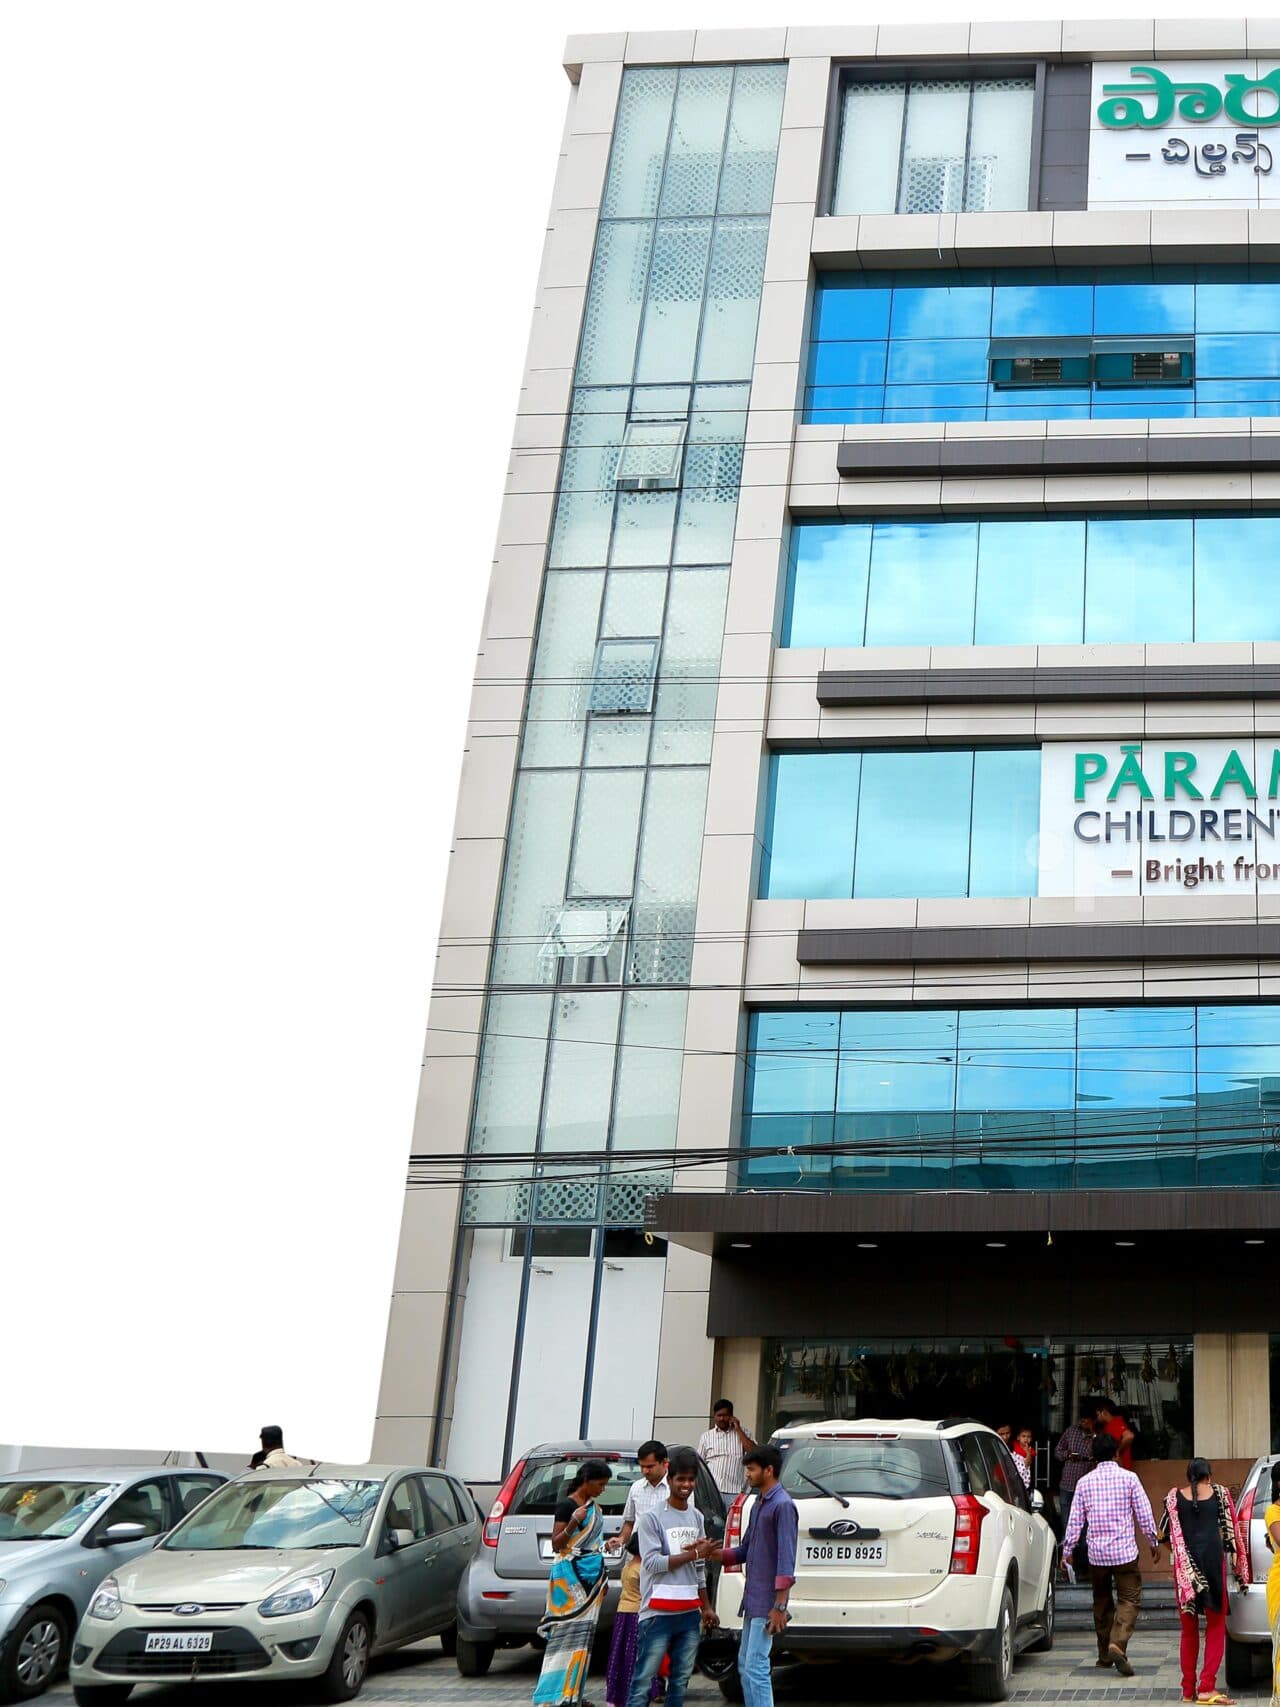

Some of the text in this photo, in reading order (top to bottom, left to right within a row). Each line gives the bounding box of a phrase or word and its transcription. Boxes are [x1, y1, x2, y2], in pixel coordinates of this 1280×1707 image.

[1145, 859, 1225, 888] Bright
[806, 1547, 883, 1559] TS08 ED 8925
[148, 1638, 171, 1649] AP29
[173, 1638, 184, 1649] AL
